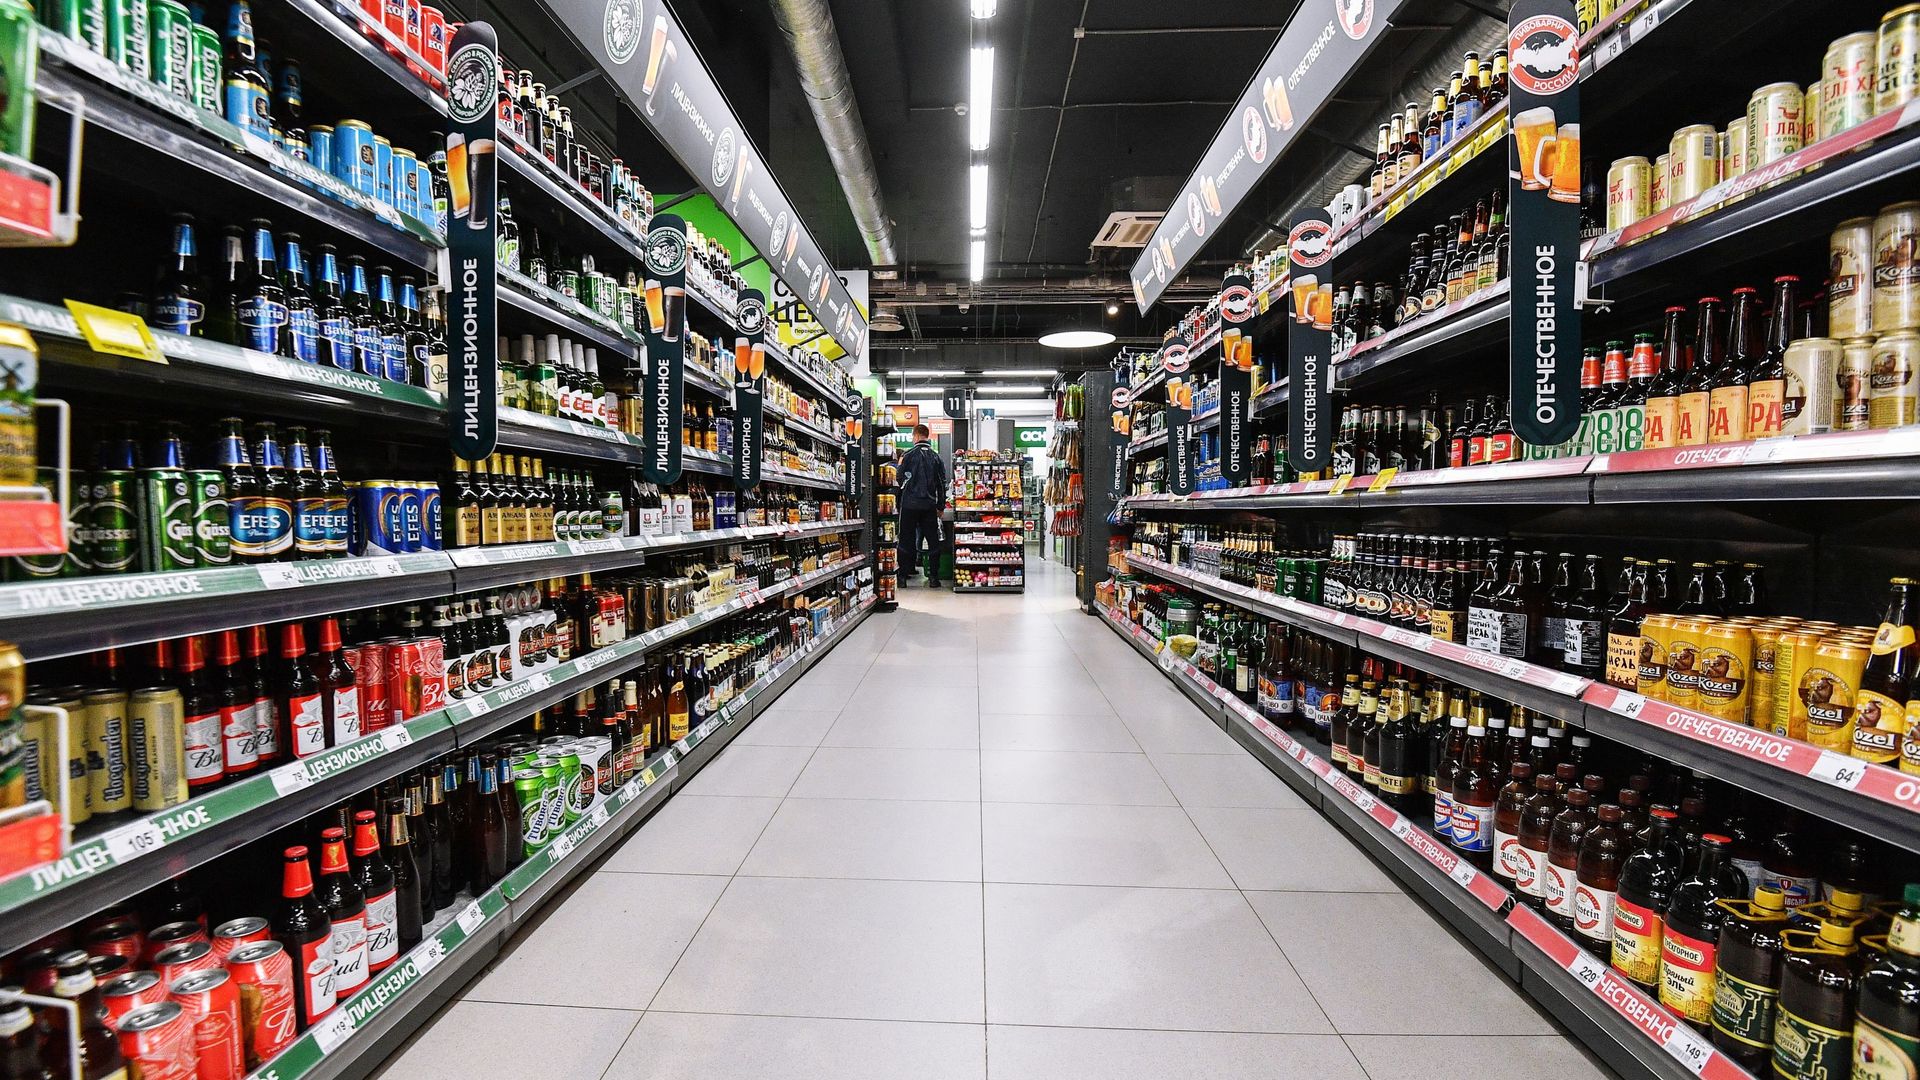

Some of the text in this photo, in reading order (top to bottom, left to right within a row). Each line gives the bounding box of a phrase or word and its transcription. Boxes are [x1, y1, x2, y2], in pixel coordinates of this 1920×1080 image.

[1514, 20, 1565, 40] ПИВОВАРНИ
[1288, 20, 1336, 90] ОТЕЧЕСТВЕННОЕ
[1533, 69, 1574, 90] РОССИИ
[670, 81, 715, 146] ЛИЦЕНЗИОННОЕ
[463, 258, 481, 440] ЛИЦЕНЗИОННОЕ
[1536, 245, 1556, 424] ОТЕЧЕСТВЕННОЕ
[656, 358, 671, 472] ЛИЦЕНЗИОННОЕ
[948, 397, 960, 411] 11
[1304, 355, 1317, 459] ОТЕЧЕСТВЕННОЕ
[741, 416, 752, 480] ИМПОРТНОЕ
[1231, 390, 1240, 472] ОТЕЧЕСТВЕННОЕ
[1179, 425, 1187, 488] ОТЕЧЕСТВЕННОЕ
[239, 514, 281, 529] EFES
[407, 504, 420, 542] EFES
[18, 575, 204, 610] ЛИЦЕНЗИОННОЕ
[1625, 702, 1638, 714] 64
[1665, 710, 1794, 763] ОТЕЧЕСТВЕННОЕ
[100, 717, 126, 802] Hoegaarden
[1835, 767, 1854, 784] 64
[528, 790, 549, 841] TUBORG
[128, 831, 153, 851] 105
[1664, 937, 1699, 962] ТРЕХГОРНОЕ
[1579, 966, 1598, 984] 229
[1663, 962, 1695, 986] Пряный
[1685, 1043, 1701, 1060] 149
